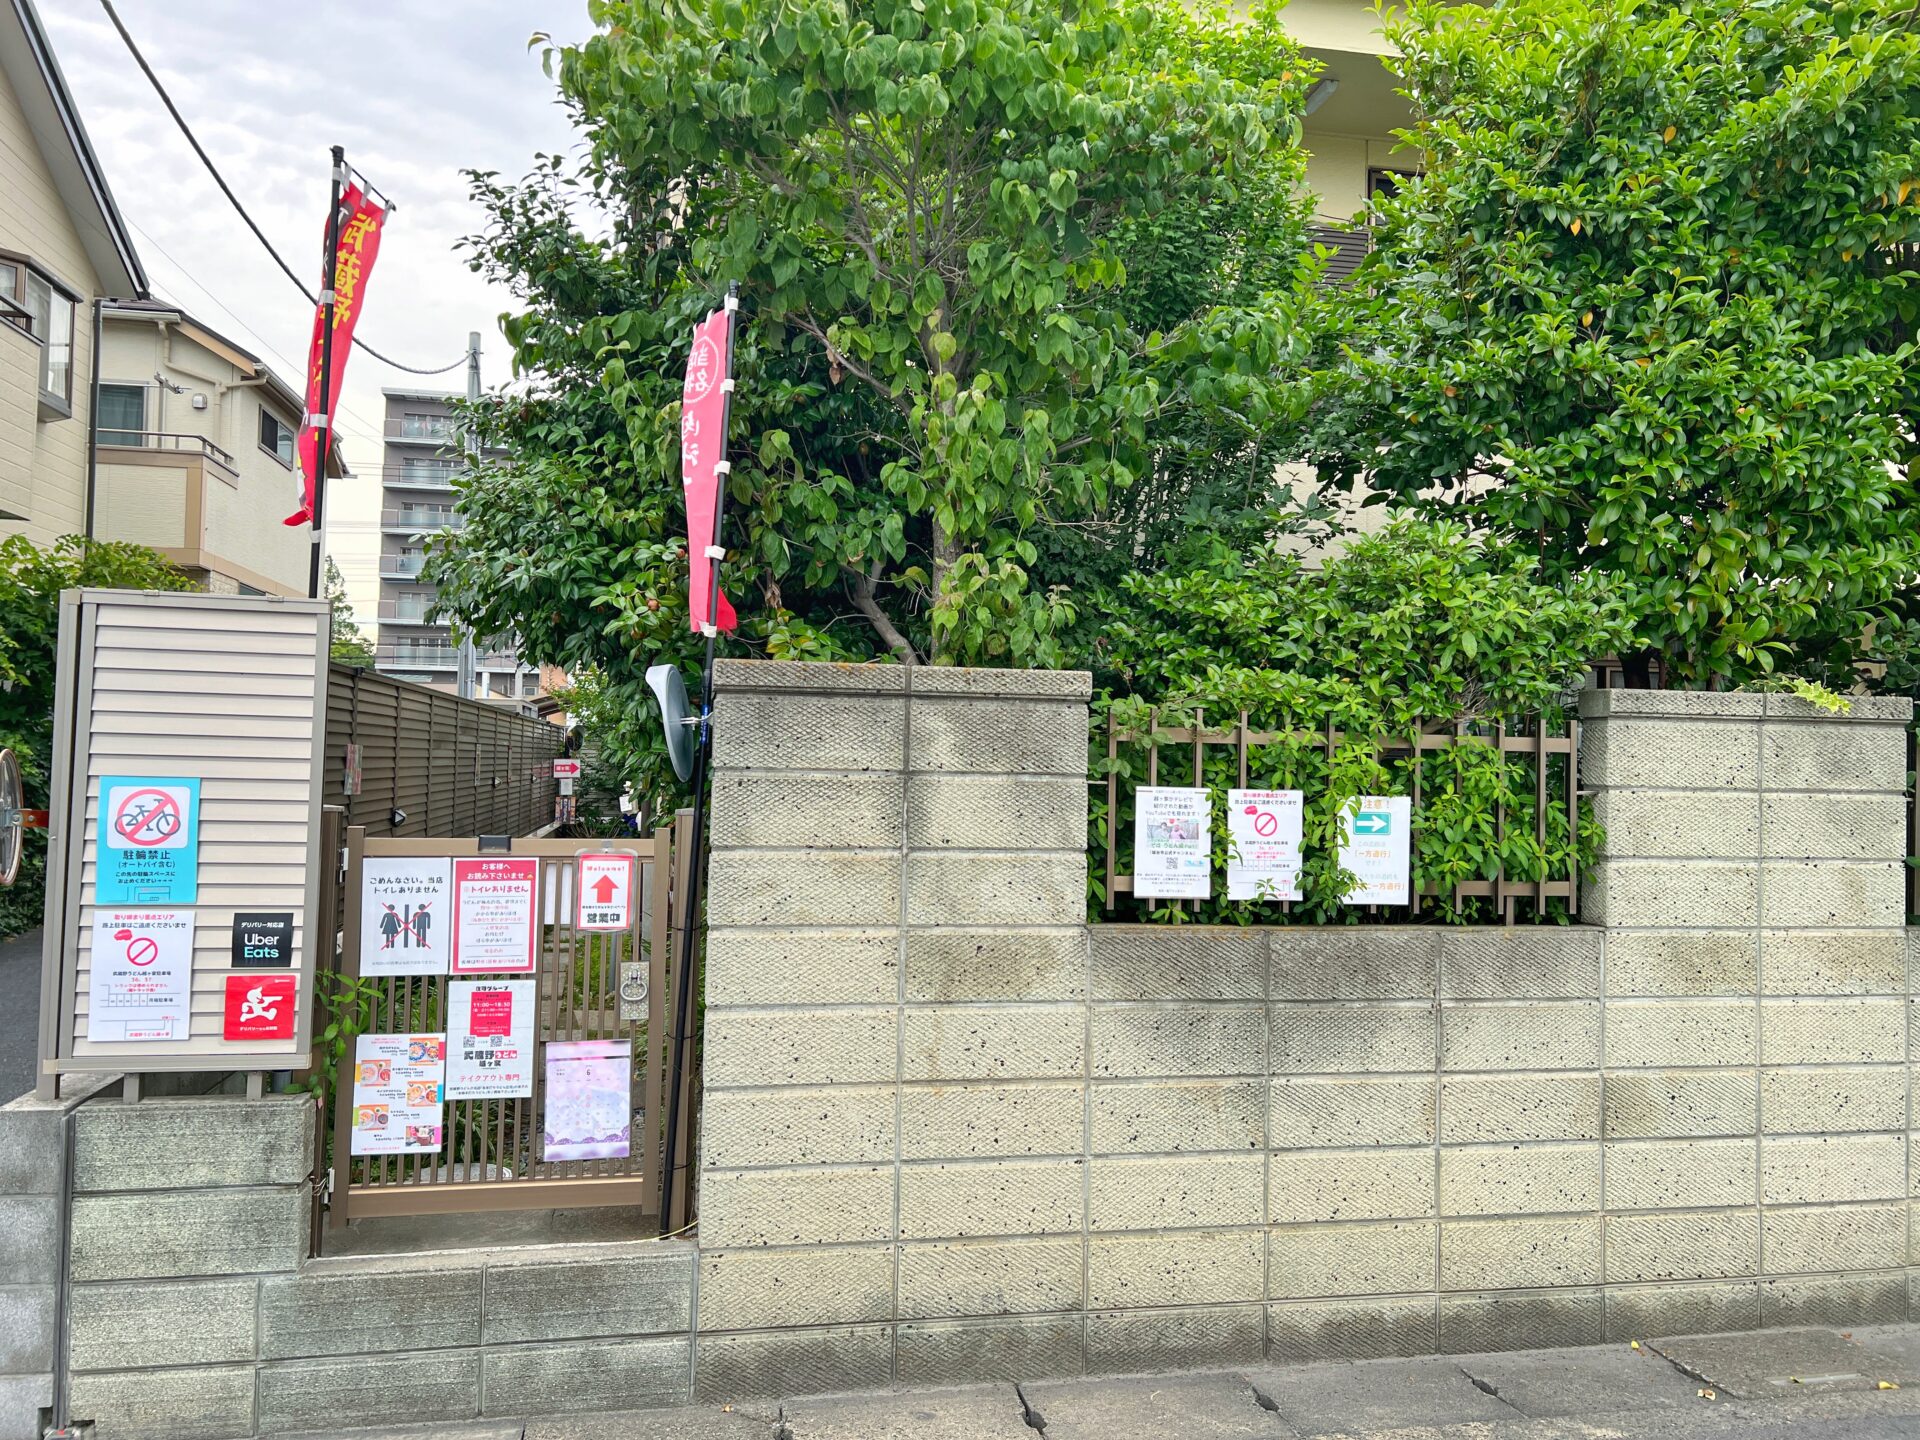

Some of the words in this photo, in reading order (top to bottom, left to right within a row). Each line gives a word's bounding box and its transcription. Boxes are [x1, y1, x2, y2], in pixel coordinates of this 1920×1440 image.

[123, 850, 171, 860] 駐輪禁止
[466, 872, 525, 880] お読み下さいませ
[374, 886, 439, 894] トイレありません
[470, 885, 529, 893] トイレありません
[586, 912, 621, 924] 営業中
[244, 933, 280, 945] Uber
[244, 946, 280, 958] Eats
[463, 1050, 518, 1060] 武蔵野うどん
[459, 1073, 520, 1082] テイクアウト専門
